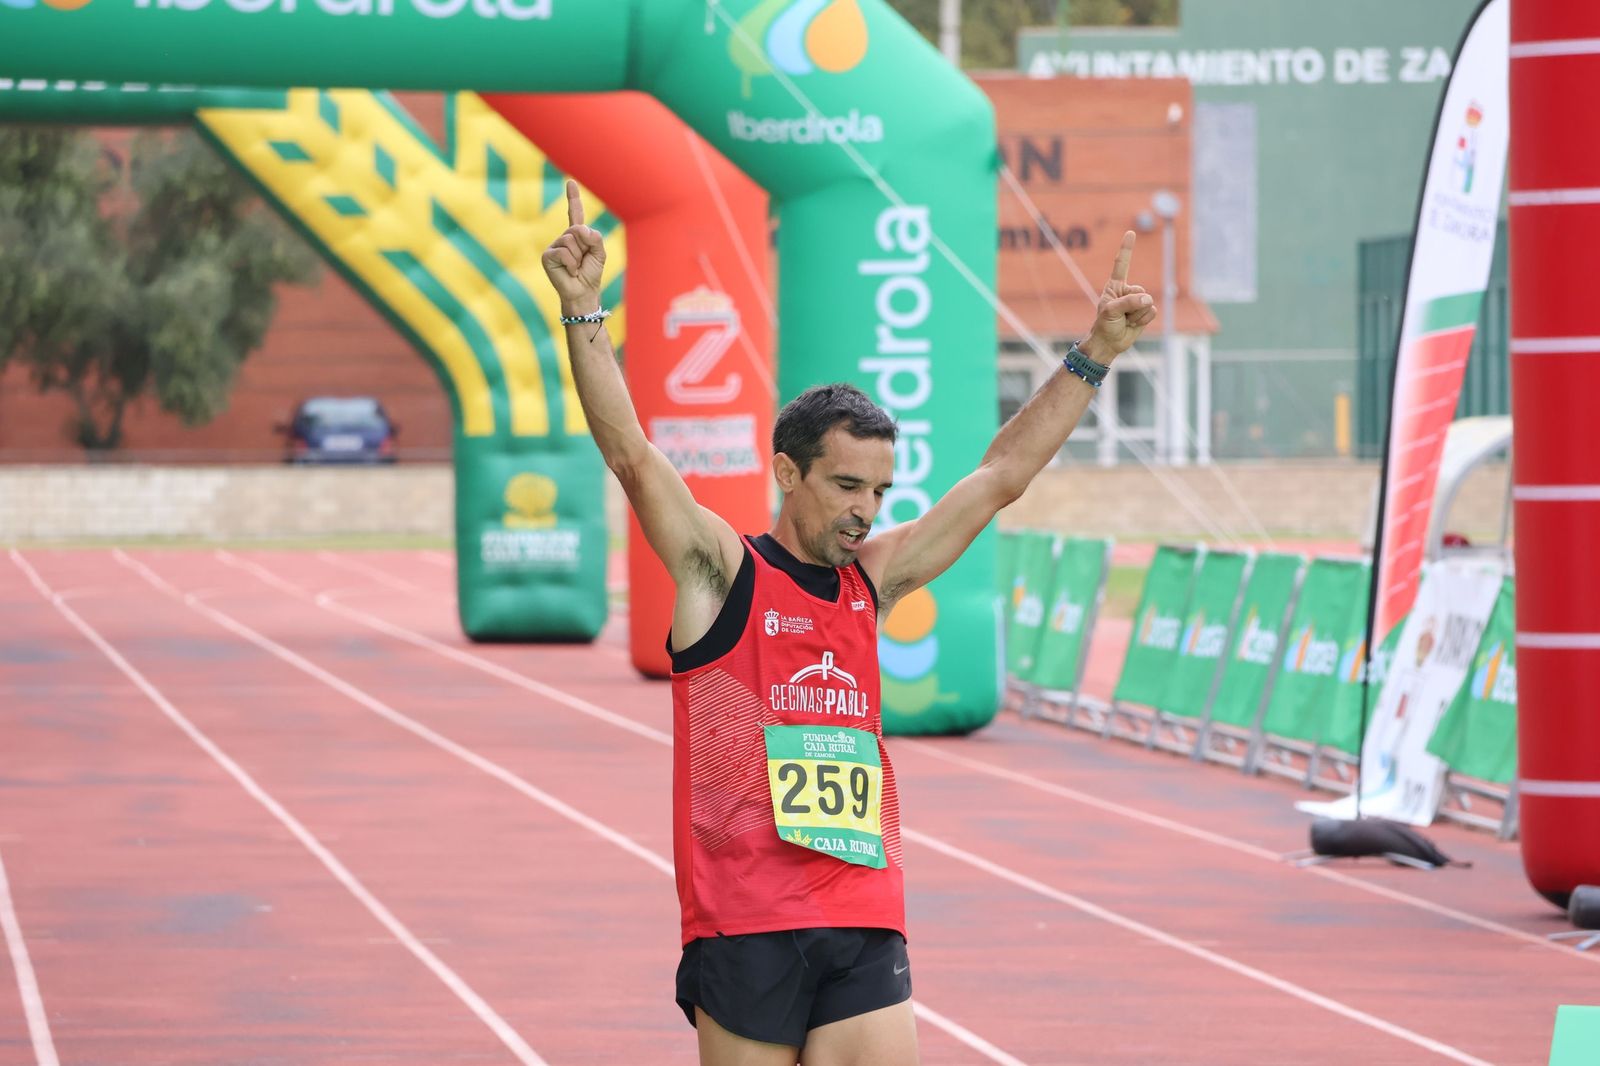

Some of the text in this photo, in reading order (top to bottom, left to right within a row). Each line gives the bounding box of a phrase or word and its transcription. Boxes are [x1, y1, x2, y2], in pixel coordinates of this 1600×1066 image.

[1029, 48, 1325, 85] AYUNTAMIENTO
[1334, 50, 1390, 83] DE
[803, 741, 857, 754] CAJA RURAL
[778, 763, 869, 819] 259
[814, 837, 879, 858] CAJA RURAL
